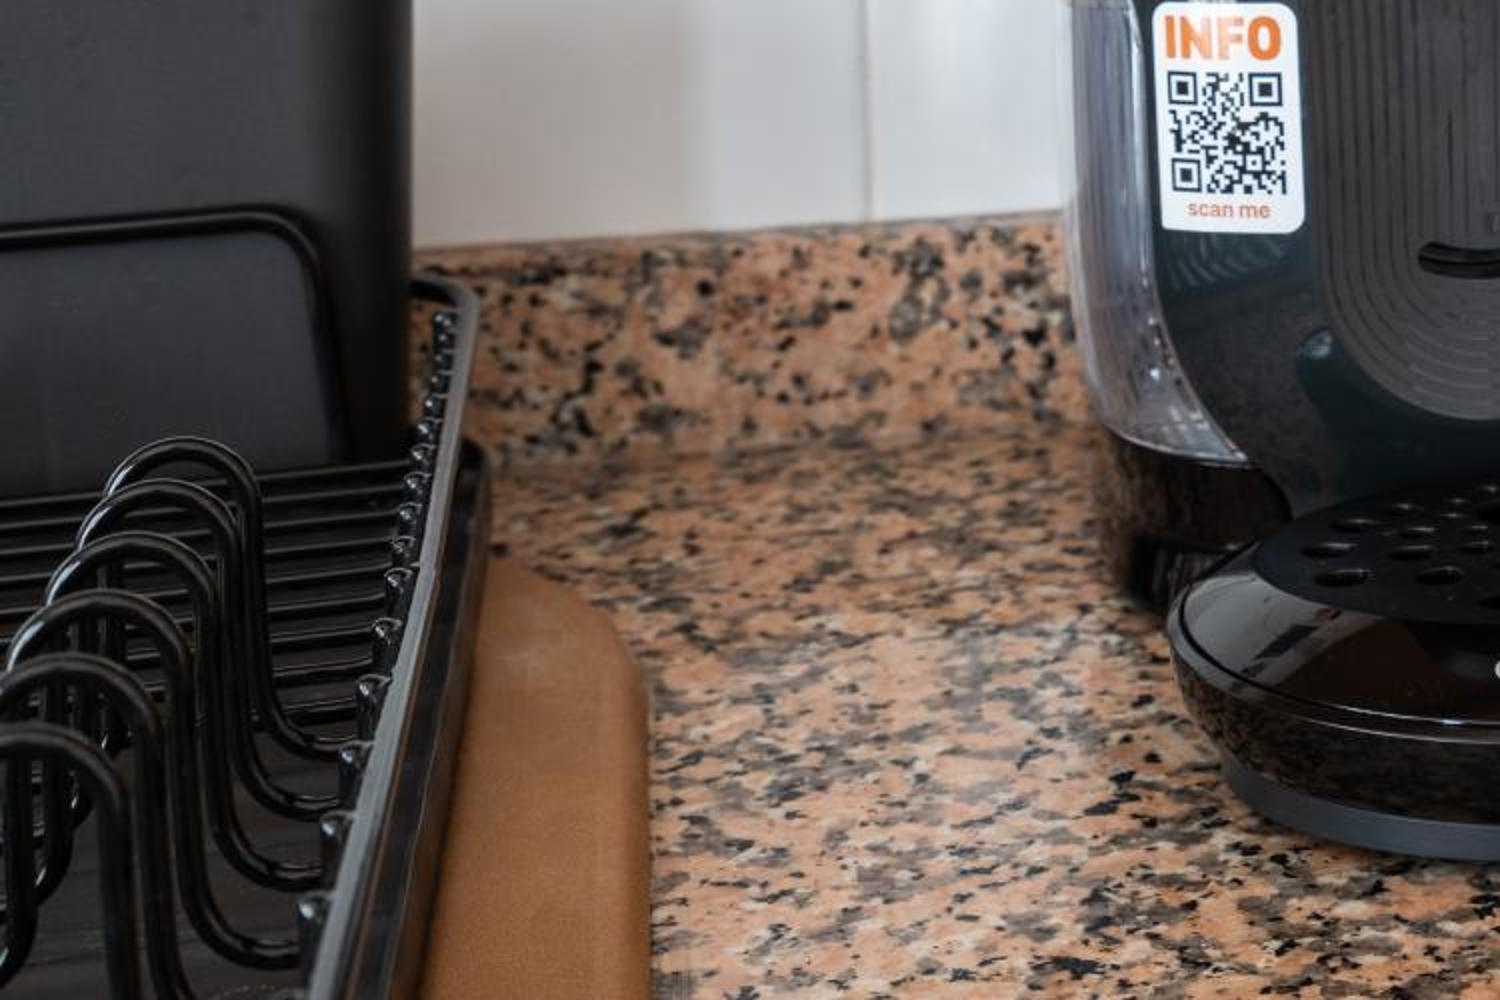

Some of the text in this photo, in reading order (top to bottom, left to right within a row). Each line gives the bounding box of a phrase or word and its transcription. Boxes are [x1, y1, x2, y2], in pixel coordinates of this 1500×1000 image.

[1164, 15, 1281, 60] INFO
[1188, 201, 1271, 219] scan me
